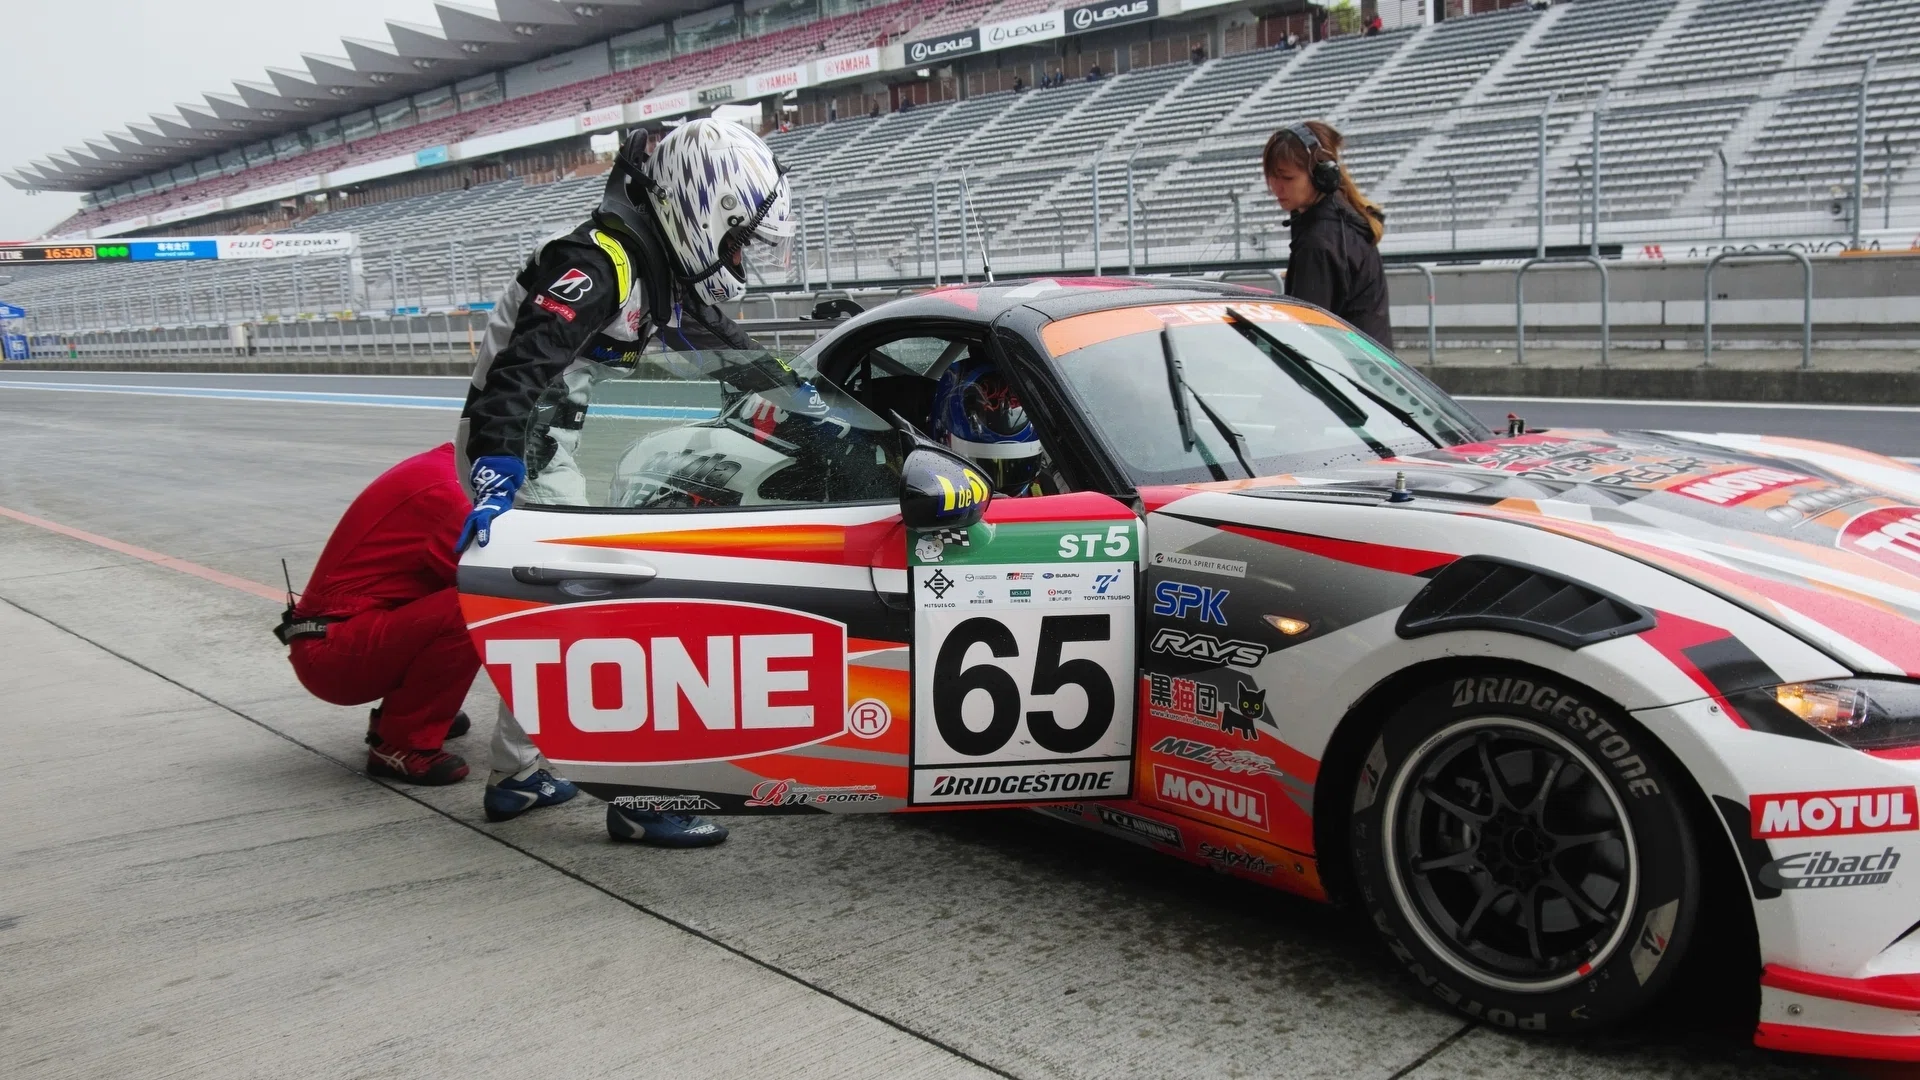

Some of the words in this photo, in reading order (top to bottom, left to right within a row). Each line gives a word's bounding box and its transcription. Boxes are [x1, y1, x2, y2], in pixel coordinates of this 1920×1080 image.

[1093, 0, 1149, 21] LEXUS
[927, 36, 973, 55] LEXUS
[1006, 20, 1056, 38] LEXUS
[764, 72, 798, 90] YAMAHA
[834, 54, 871, 74] YAMAHA
[44, 248, 94, 259] 16:50.8
[229, 240, 260, 249] FUJI
[262, 238, 341, 250] SPEEDWAY
[1679, 468, 1811, 503] MOTUL
[1058, 525, 1131, 559] ST5
[1166, 556, 1192, 566] MAZDA
[1193, 559, 1215, 569] SPIRIT
[1216, 562, 1244, 573] RACING
[1154, 580, 1230, 626] SPK
[1152, 630, 1266, 666] RAYS
[485, 633, 815, 735] TONE
[933, 614, 1115, 756] 65
[1150, 672, 1219, 719] 黒猫団
[1452, 677, 1661, 800] BRIDGESTONE
[930, 771, 1114, 796] BRIDGESTONE
[1162, 773, 1262, 823] MOTUL
[1759, 793, 1912, 833] MOTUL
[1759, 847, 1901, 889] Eibach
